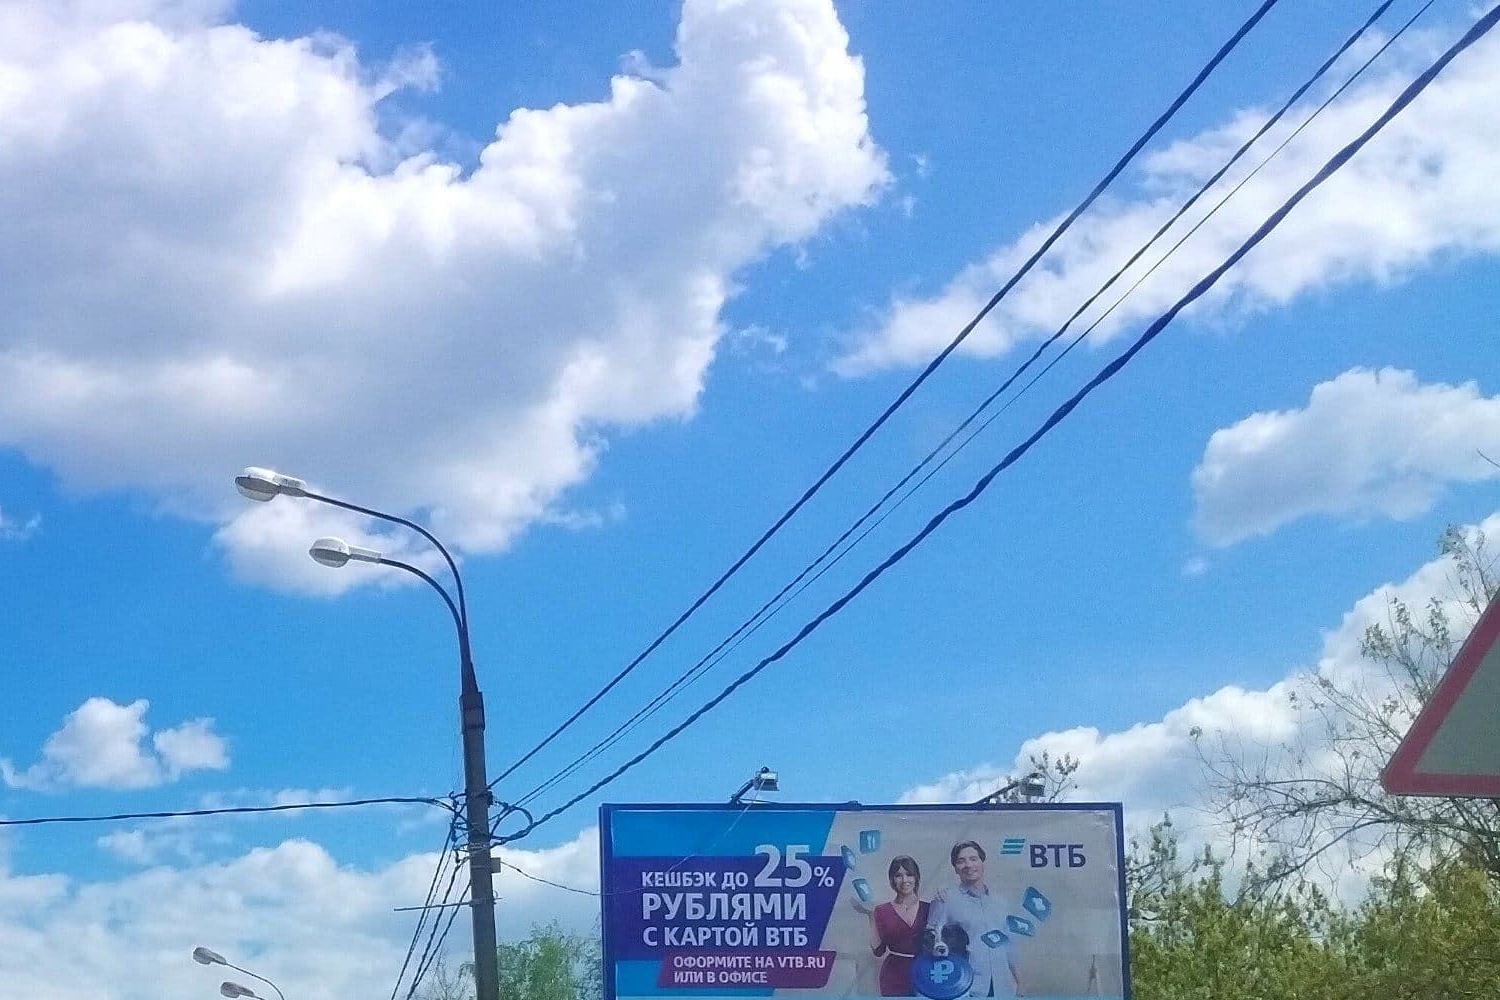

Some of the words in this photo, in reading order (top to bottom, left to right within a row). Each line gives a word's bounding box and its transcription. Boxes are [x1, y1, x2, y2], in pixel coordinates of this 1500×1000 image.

[642, 871, 717, 887] КЕШБЭК
[721, 872, 749, 890] ДО
[754, 844, 835, 888] 25%
[1030, 844, 1086, 868] ВТБ
[642, 892, 807, 921] РУБЛЯМИ
[643, 926, 658, 946] С
[664, 922, 758, 946] КАРТОЙ
[766, 926, 808, 946] ВТБ
[673, 956, 751, 969] ОФОРМИТЕ
[755, 957, 774, 968] НА
[777, 956, 826, 969] VTB.RU
[674, 971, 704, 983] ИЛИ
[707, 972, 716, 983] В
[719, 971, 768, 984] ОФИСЕ
